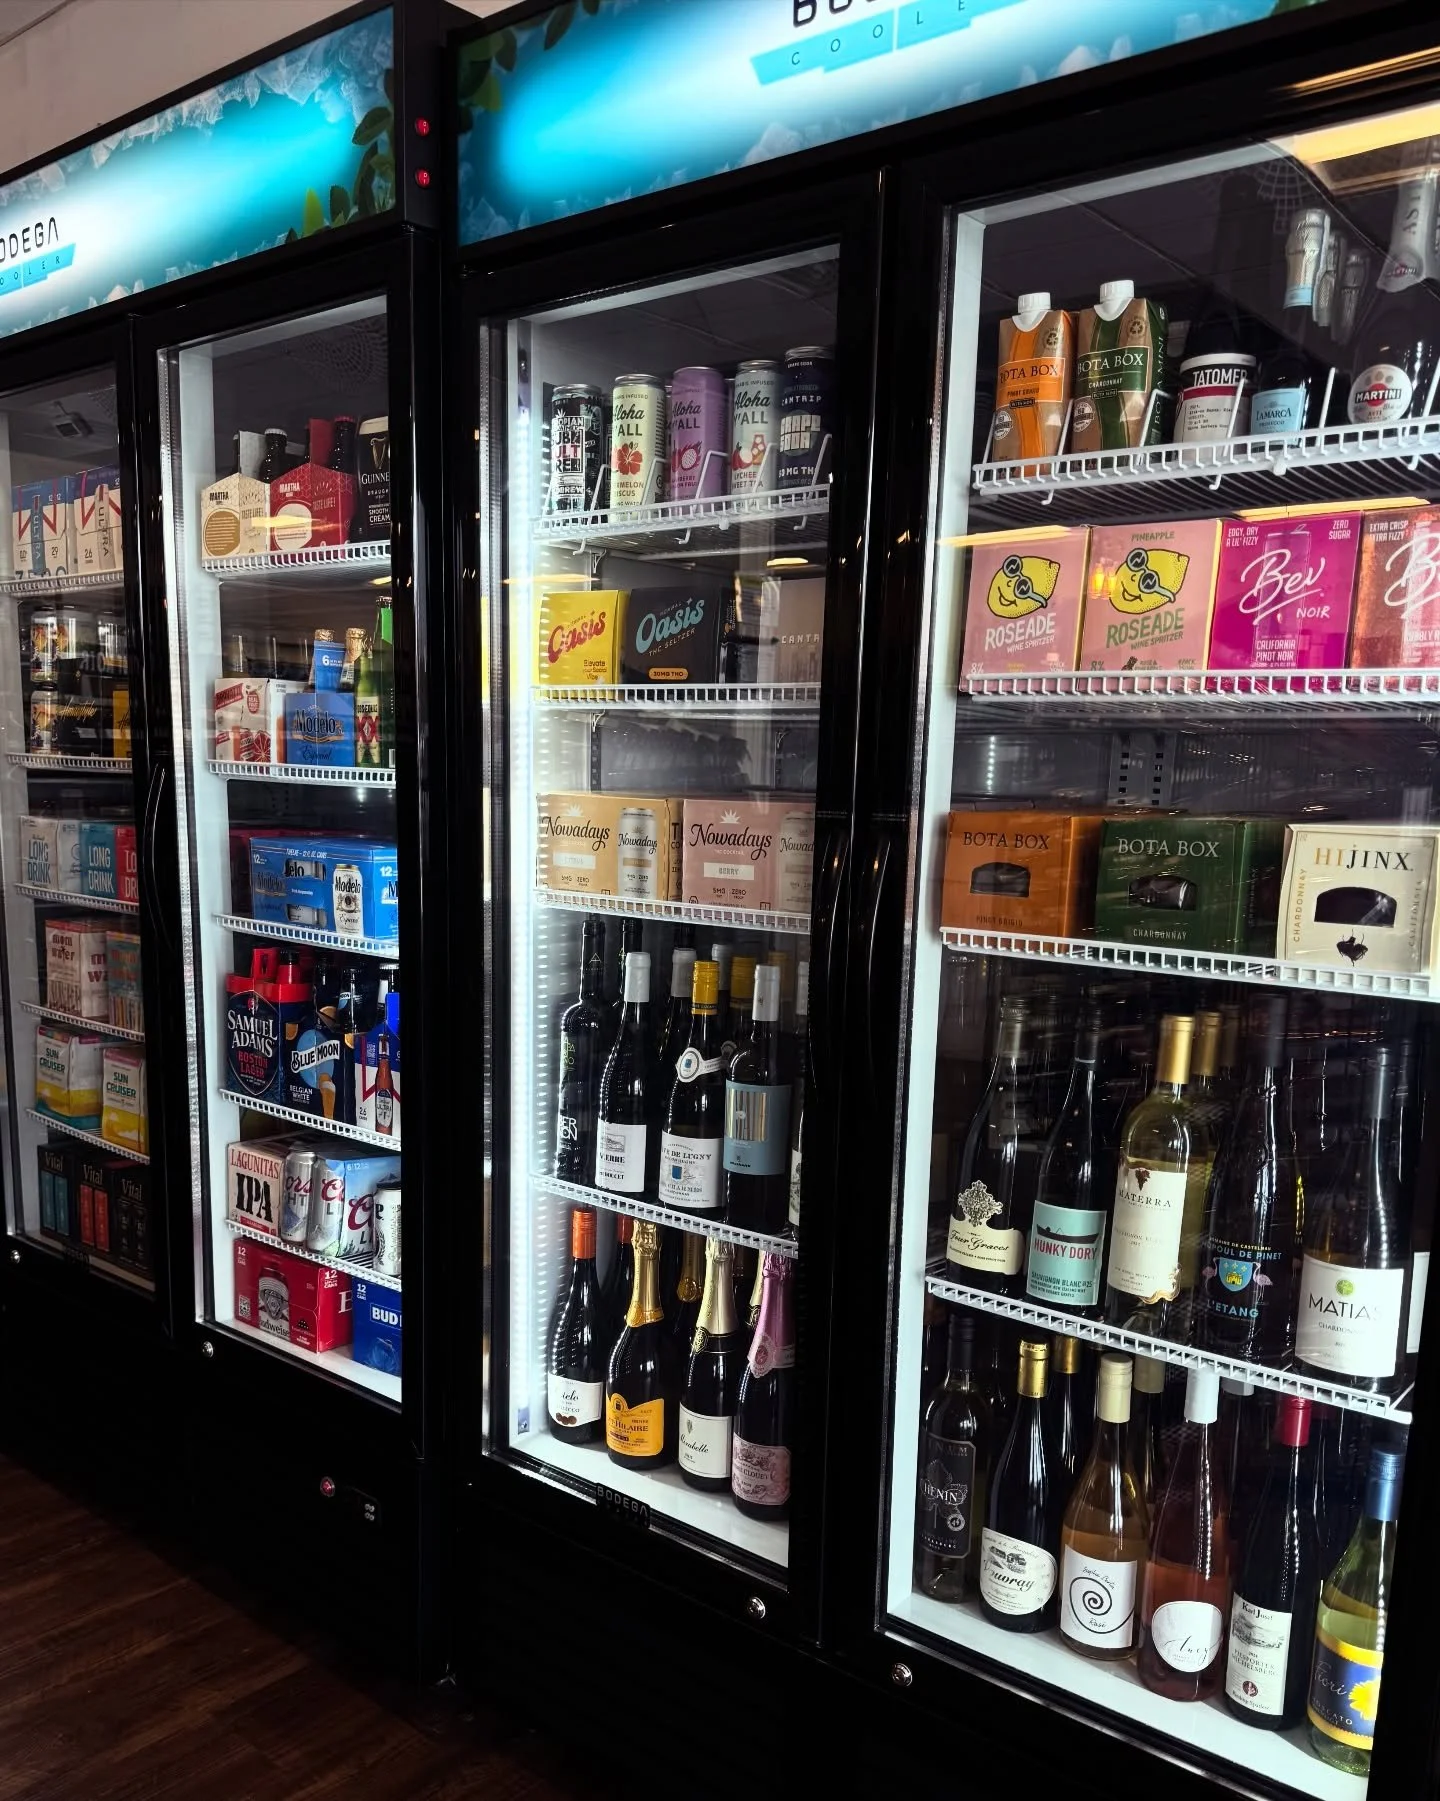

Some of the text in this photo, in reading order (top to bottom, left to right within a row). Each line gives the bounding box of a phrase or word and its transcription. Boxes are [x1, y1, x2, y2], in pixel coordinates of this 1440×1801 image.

[1114, 353, 1143, 367] BOX
[1031, 364, 1059, 377] BOX
[1193, 368, 1248, 387] TATOMER
[1088, 377, 1123, 389] CHARDONNAY
[734, 390, 770, 410] Aloha
[781, 394, 822, 406] CANTRIP
[1355, 389, 1402, 404] MARTINI
[734, 410, 769, 426] Y'ALL
[781, 415, 822, 435] GRAPE
[780, 432, 812, 453] SODA
[361, 473, 389, 485] GUINNE
[786, 467, 799, 476] MG
[368, 507, 389, 516] SMOOTH
[98, 506, 110, 557] ULTRA
[1246, 526, 1259, 535] DRY
[1332, 520, 1349, 530] ZERO
[1369, 520, 1409, 532] EXTRA CRISP
[33, 515, 42, 560] ULTRA
[1131, 530, 1175, 542] PINEAPPLE
[1242, 536, 1259, 546] FIZZY
[1328, 529, 1351, 540] SUGAR
[1388, 530, 1404, 542] FIZZY
[1239, 549, 1326, 615] Bev
[1296, 605, 1331, 619] NOIR
[635, 599, 705, 654] Oasis
[985, 612, 1057, 651] ROSEADE
[1106, 607, 1185, 649] ROSEADE
[547, 611, 607, 664] Oasis
[648, 628, 697, 657] THC SELTZER
[1007, 635, 1056, 654] WINE SPRITZER
[1131, 631, 1184, 651] WINE SPRITZER
[1256, 639, 1296, 651] CALIFORNIA
[322, 655, 330, 667] 6
[1255, 650, 1295, 662] PINOT NOIR
[971, 662, 984, 674] 8%
[1091, 660, 1105, 671] 8%
[295, 710, 336, 735] Modelo
[542, 816, 610, 851] Nowadays
[964, 831, 1050, 850] BOTA BOX
[28, 839, 49, 861] LONG
[618, 833, 658, 855] Nowadays
[690, 823, 773, 861] Nowadays
[780, 837, 815, 853] Nowad
[1118, 838, 1220, 858] BOTA BOX
[88, 845, 111, 868] LONG
[253, 854, 261, 864] 12
[28, 861, 52, 884] DRINK
[380, 866, 393, 877] 12
[718, 867, 740, 876] BERRY
[88, 870, 115, 894] DRINK
[335, 875, 361, 894] Modelo
[731, 887, 747, 896] ZERO
[1293, 867, 1308, 943] CHARDONNAY
[976, 914, 1024, 928] PINOT GRIGIO
[1408, 879, 1423, 948] CALIFORNIA
[52, 934, 73, 946] mom
[1132, 927, 1187, 941] CHARDONNAY
[52, 946, 75, 962] water
[227, 1009, 278, 1041] SAMUEL
[231, 1030, 275, 1058] ADAMS
[45, 1047, 59, 1059] SUN
[238, 1050, 269, 1069] BOSTON
[317, 1043, 339, 1062] MOON
[39, 1058, 66, 1074] CRUISER
[240, 1063, 265, 1079] LAGER
[113, 1071, 129, 1084] SUN
[106, 1081, 137, 1099] CRUISER
[289, 1084, 313, 1095] BELGIAN
[292, 1093, 310, 1101] WHITE
[44, 1151, 64, 1173] Vital
[671, 1150, 681, 1158] DE
[683, 1152, 712, 1161] LUGNY
[231, 1149, 279, 1180] LAGUNITAS
[83, 1164, 104, 1186] Vital
[121, 1178, 143, 1201] Vital
[235, 1172, 273, 1223] IPA
[1118, 1190, 1171, 1208] MATERRA
[237, 1246, 247, 1257] 12
[1034, 1238, 1098, 1261] HUNKY DORY
[1239, 1250, 1283, 1260] DE PINET
[324, 1269, 338, 1280] 12
[1031, 1272, 1082, 1288] SAUVIGNON BLANC
[356, 1283, 367, 1294] 12
[371, 1306, 399, 1325] BUD
[1206, 1298, 1259, 1318] L'ETANG
[597, 1485, 649, 1518] BODEGA
[1242, 1602, 1256, 1615] Karl
[1314, 1660, 1348, 1696] Fiori
